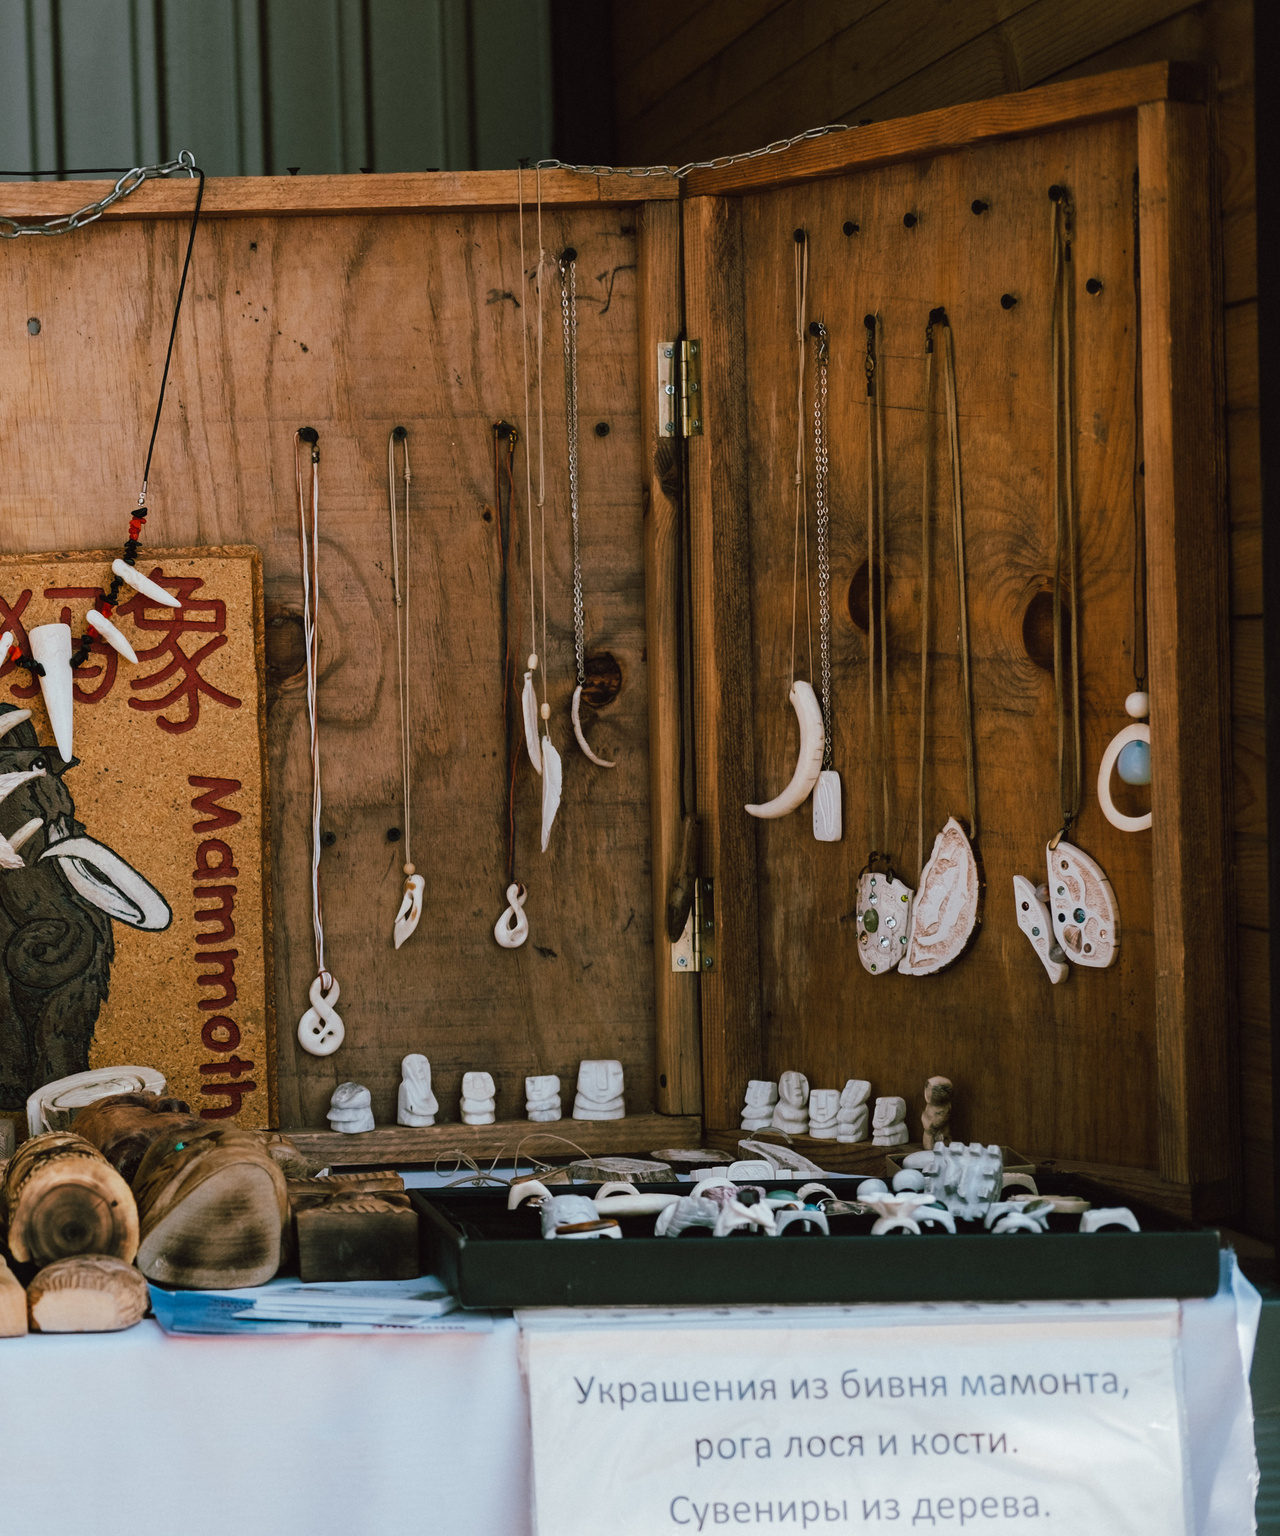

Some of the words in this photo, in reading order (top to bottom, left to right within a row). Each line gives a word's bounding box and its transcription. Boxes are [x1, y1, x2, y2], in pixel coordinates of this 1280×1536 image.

[187, 775, 258, 1120] Mammoth
[573, 1375, 777, 1411] Украшения
[790, 1377, 829, 1401] из
[840, 1368, 948, 1399] бивня
[960, 1371, 1130, 1400] мамонта,
[694, 1436, 772, 1468] рога
[783, 1434, 865, 1458] лося
[877, 1433, 898, 1456] и
[911, 1431, 1019, 1456] кости.
[669, 1495, 848, 1532] Сувениры
[862, 1498, 901, 1521] из
[911, 1495, 1051, 1527] дерева.
